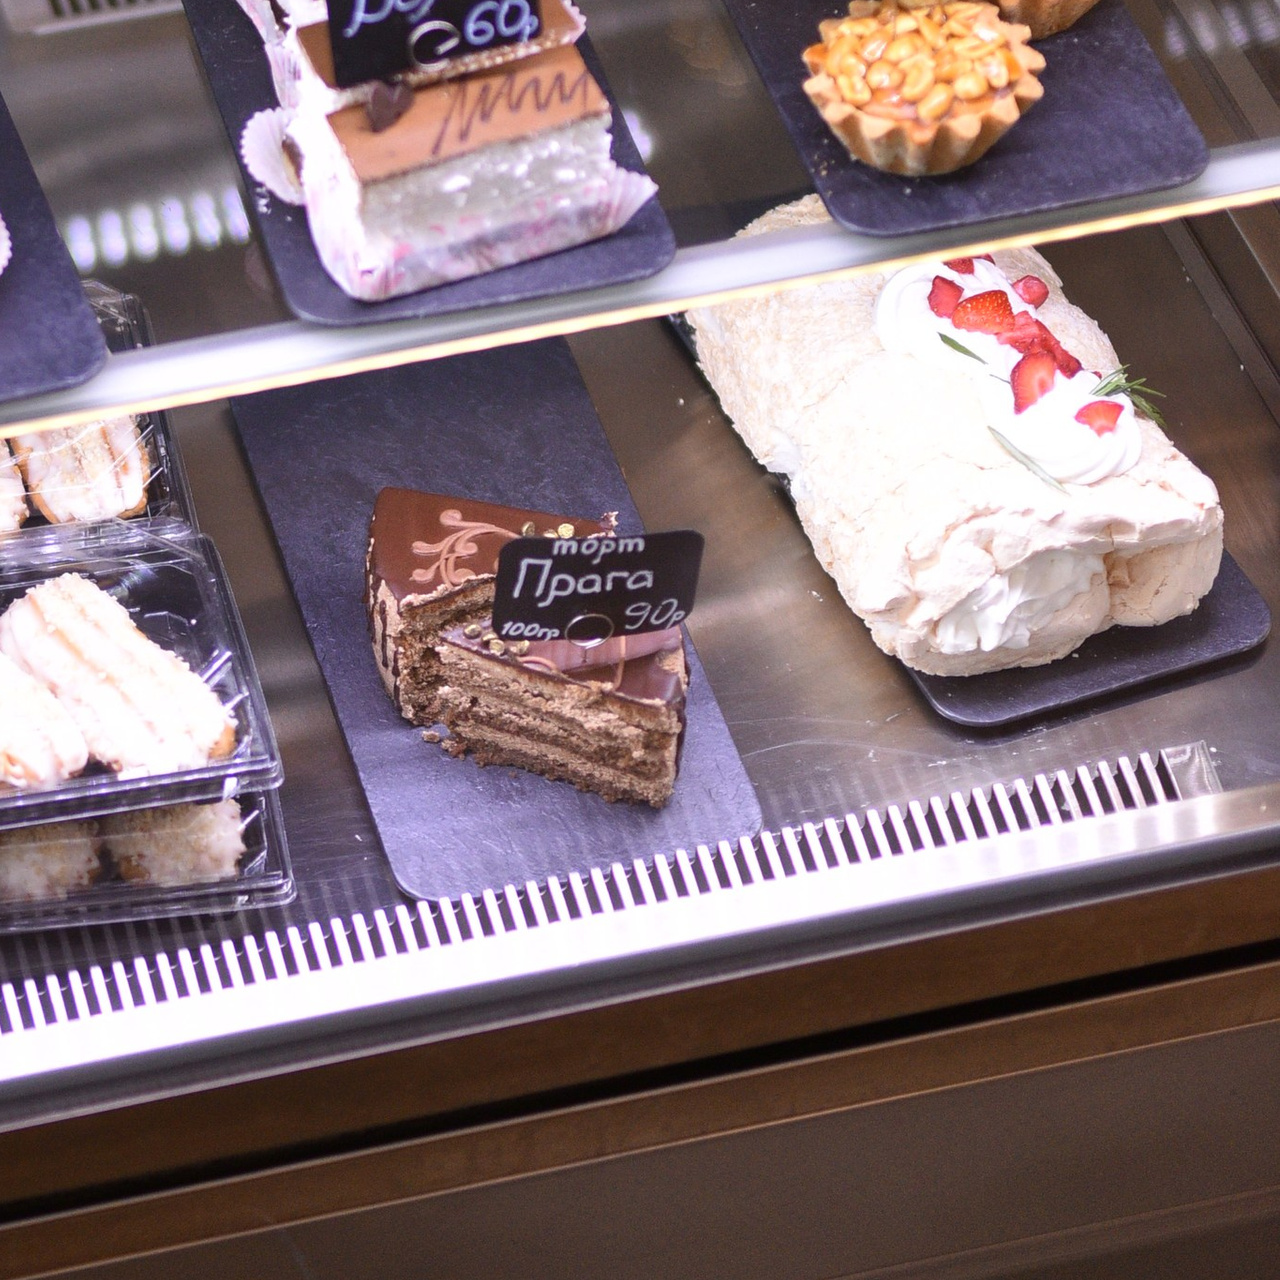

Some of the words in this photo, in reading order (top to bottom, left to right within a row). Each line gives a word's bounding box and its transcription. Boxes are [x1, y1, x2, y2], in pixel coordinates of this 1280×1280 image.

[553, 538, 645, 564] торт
[513, 558, 654, 607] Прага
[625, 598, 686, 629] 90р
[501, 621, 560, 640] 100гр
